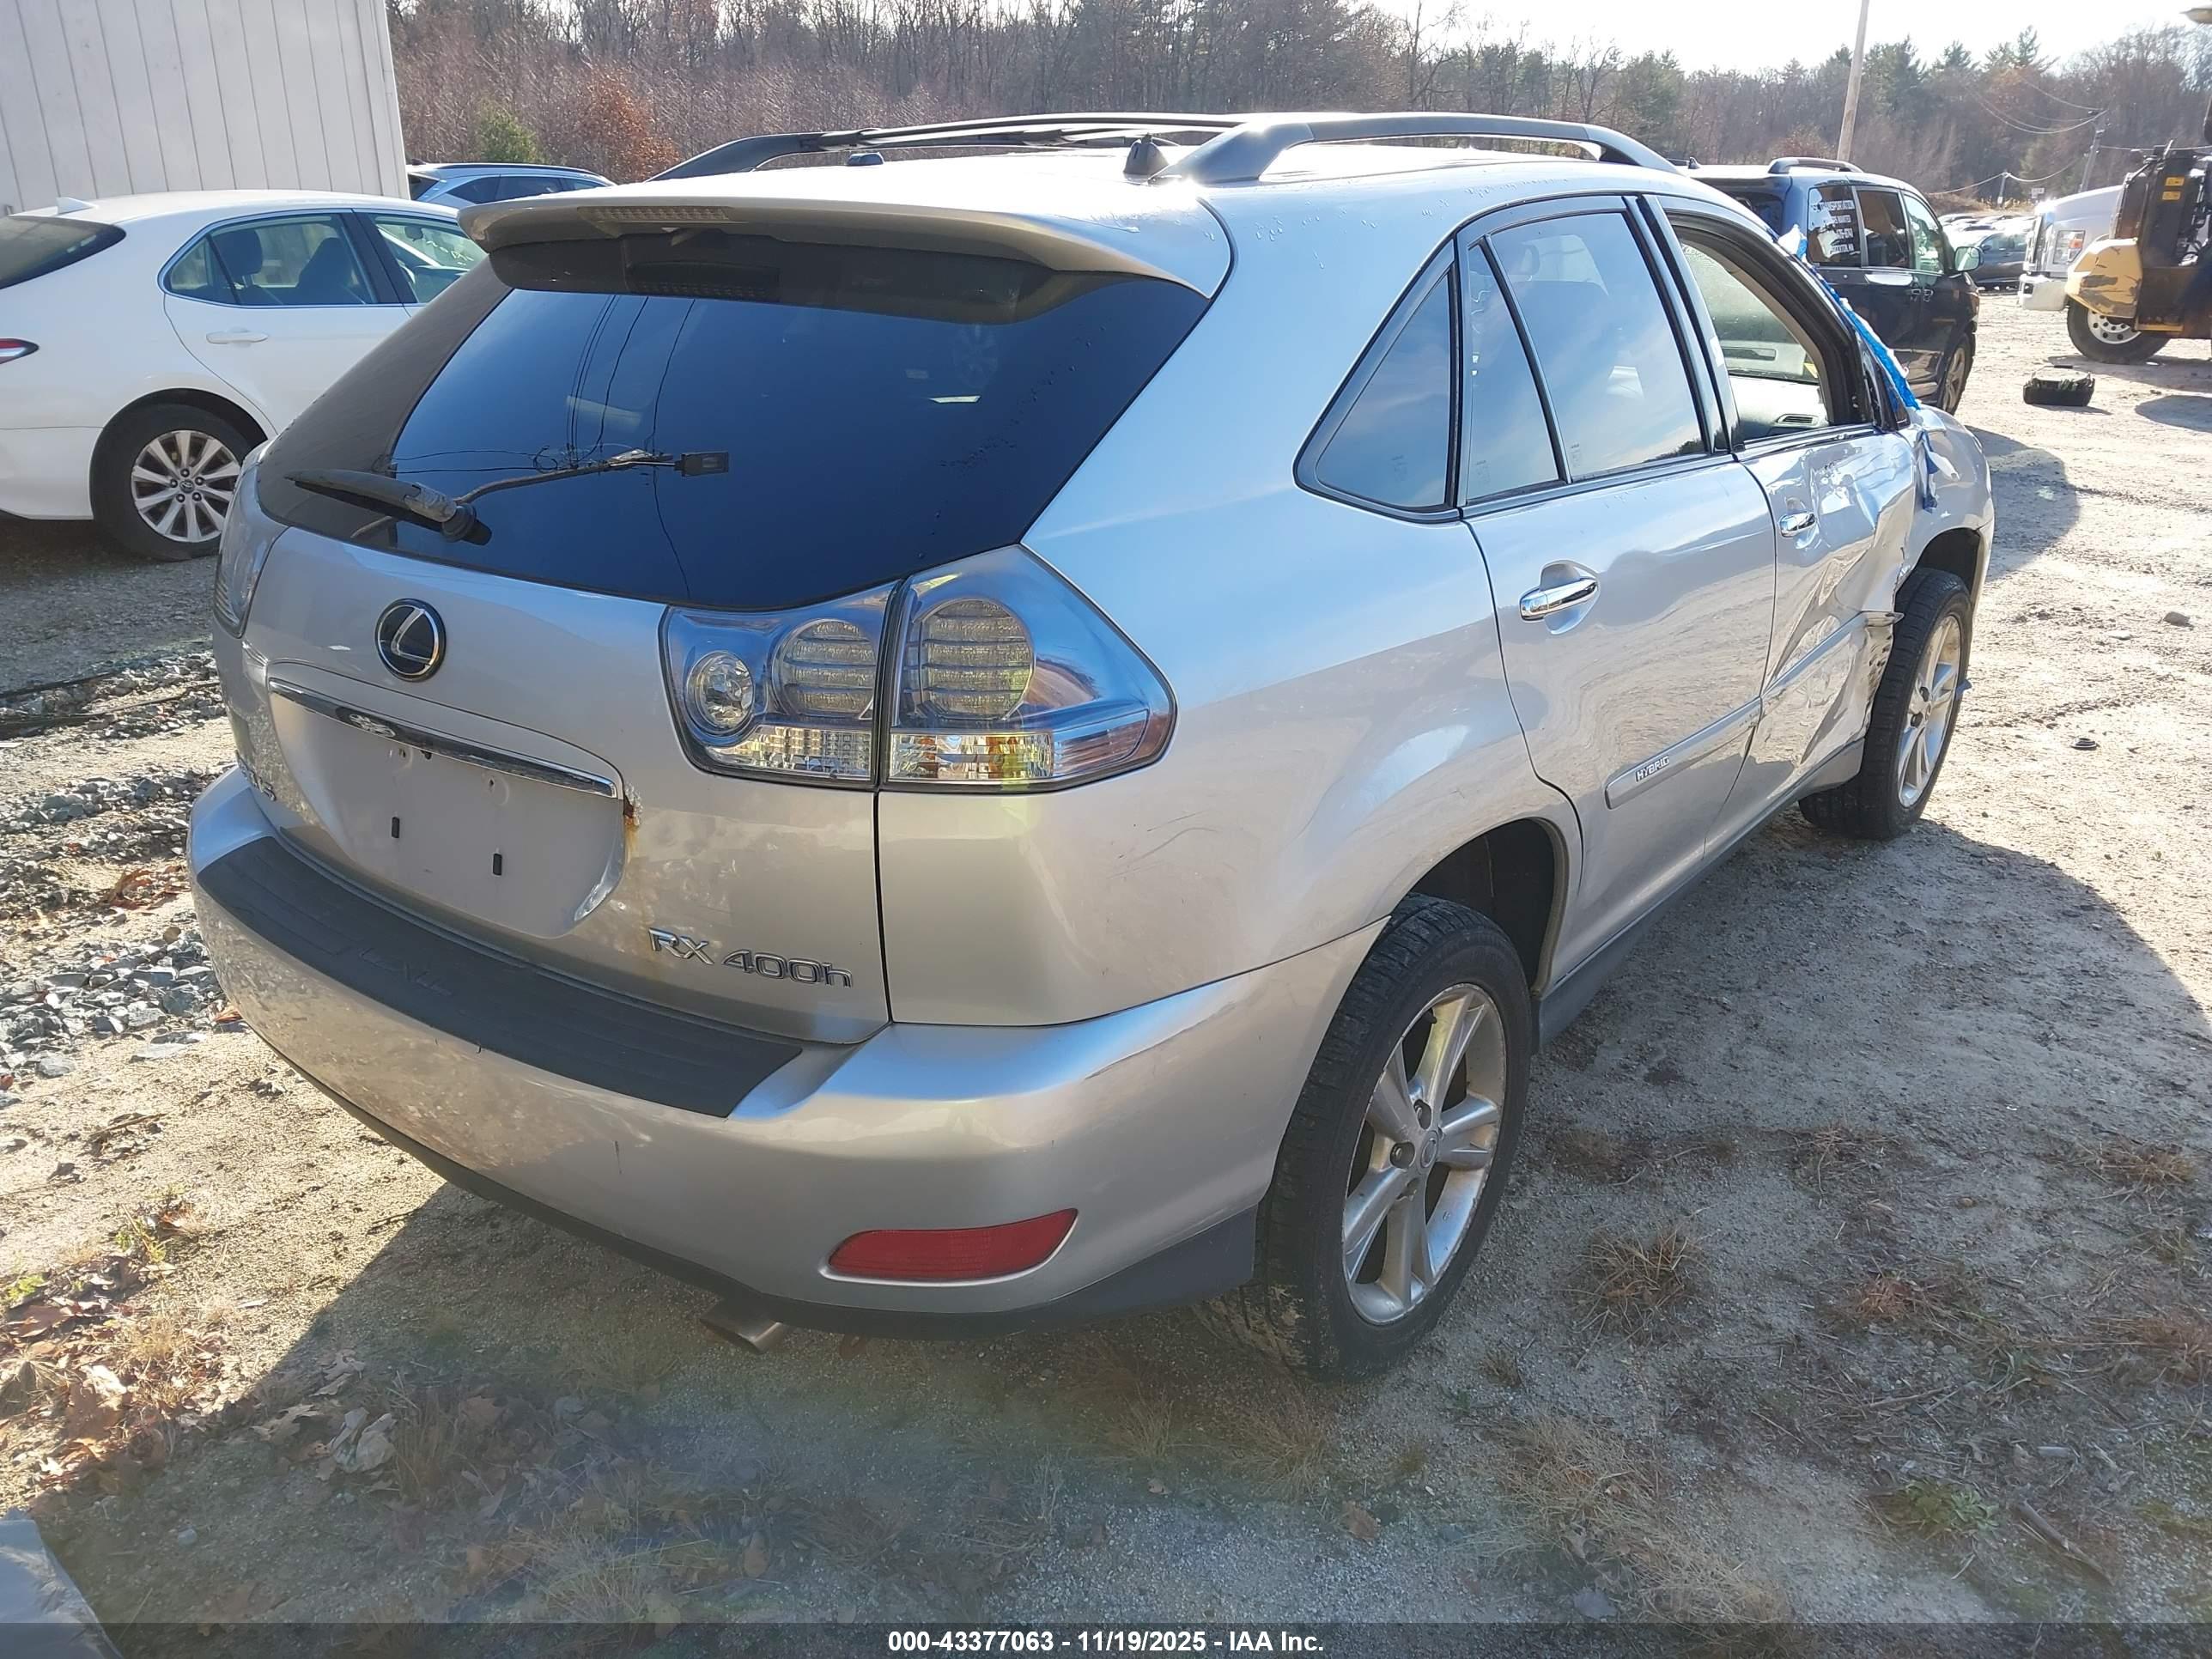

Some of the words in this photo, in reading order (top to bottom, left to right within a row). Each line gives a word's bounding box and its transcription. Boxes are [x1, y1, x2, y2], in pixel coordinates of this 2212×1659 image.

[1635, 756, 1669, 782] HYBRID
[648, 927, 714, 965] RX
[721, 948, 853, 988] 400h
